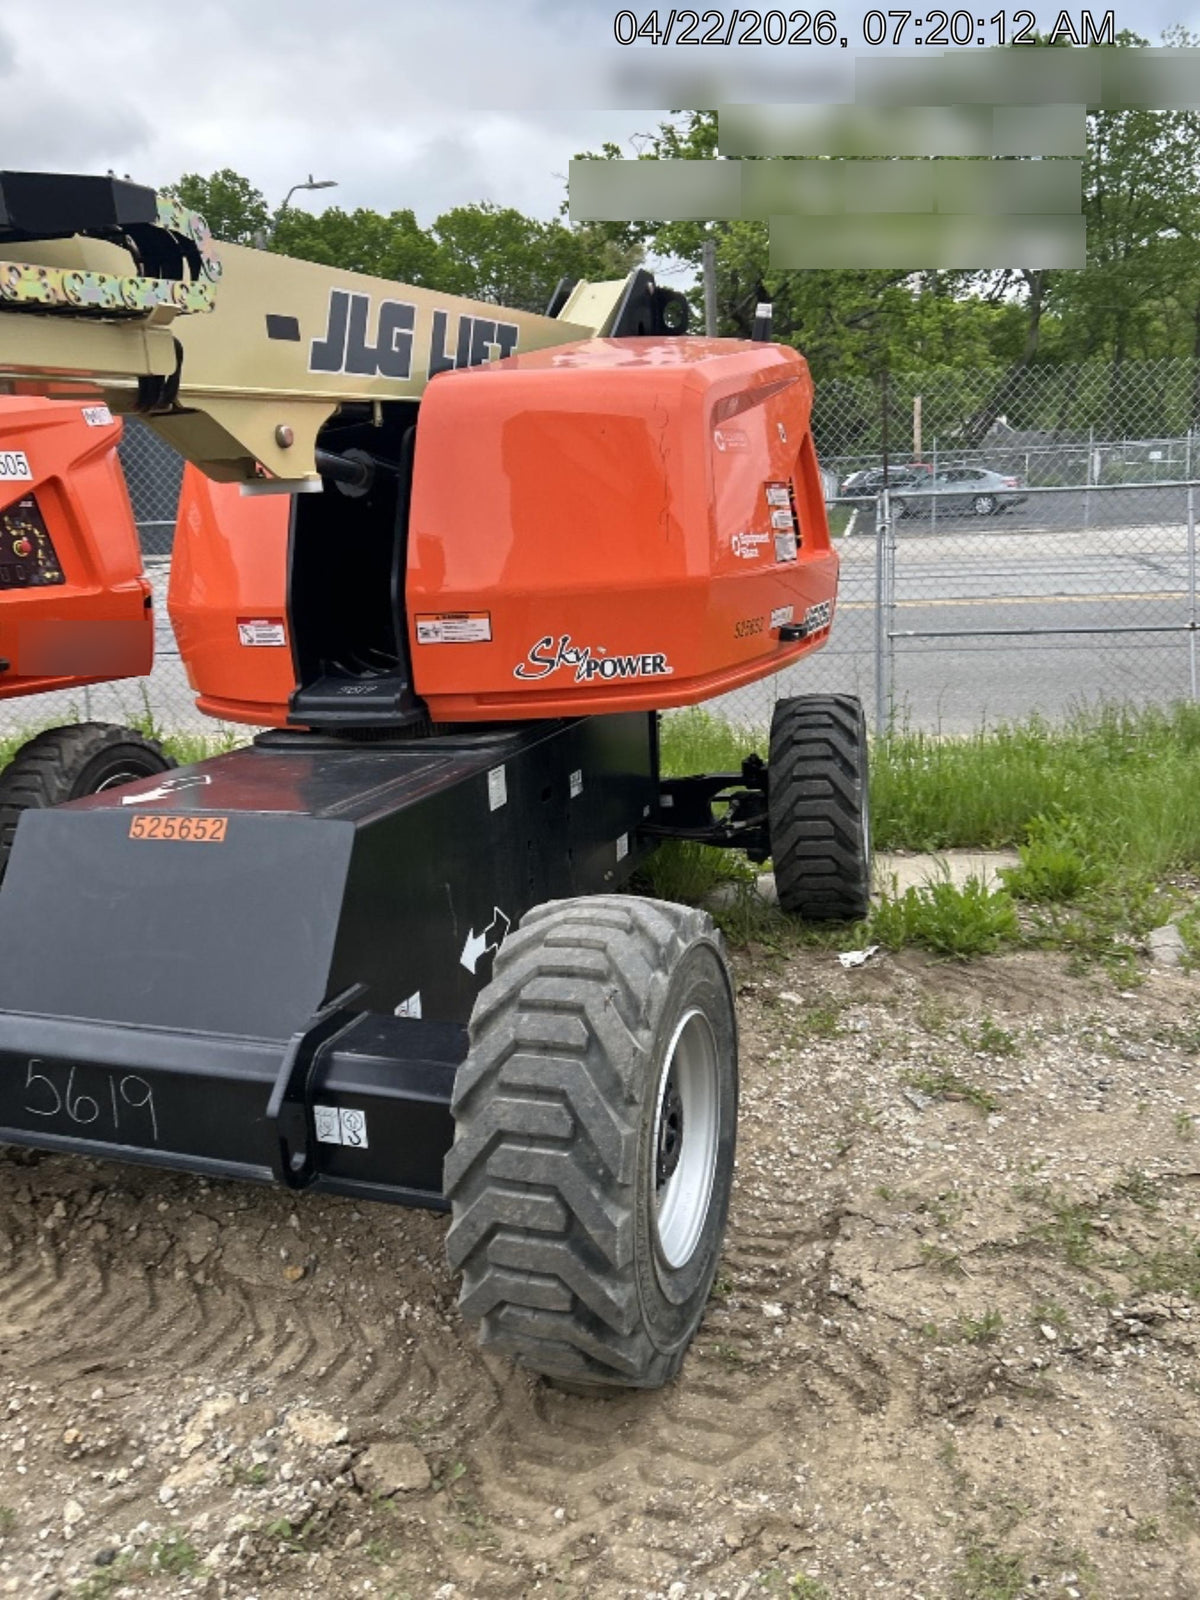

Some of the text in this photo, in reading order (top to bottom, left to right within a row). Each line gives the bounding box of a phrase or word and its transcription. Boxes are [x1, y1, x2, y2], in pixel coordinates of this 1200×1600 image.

[308, 287, 519, 381] JLG LIFT
[131, 817, 224, 840] 525652
[24, 1058, 159, 1142] 5619
